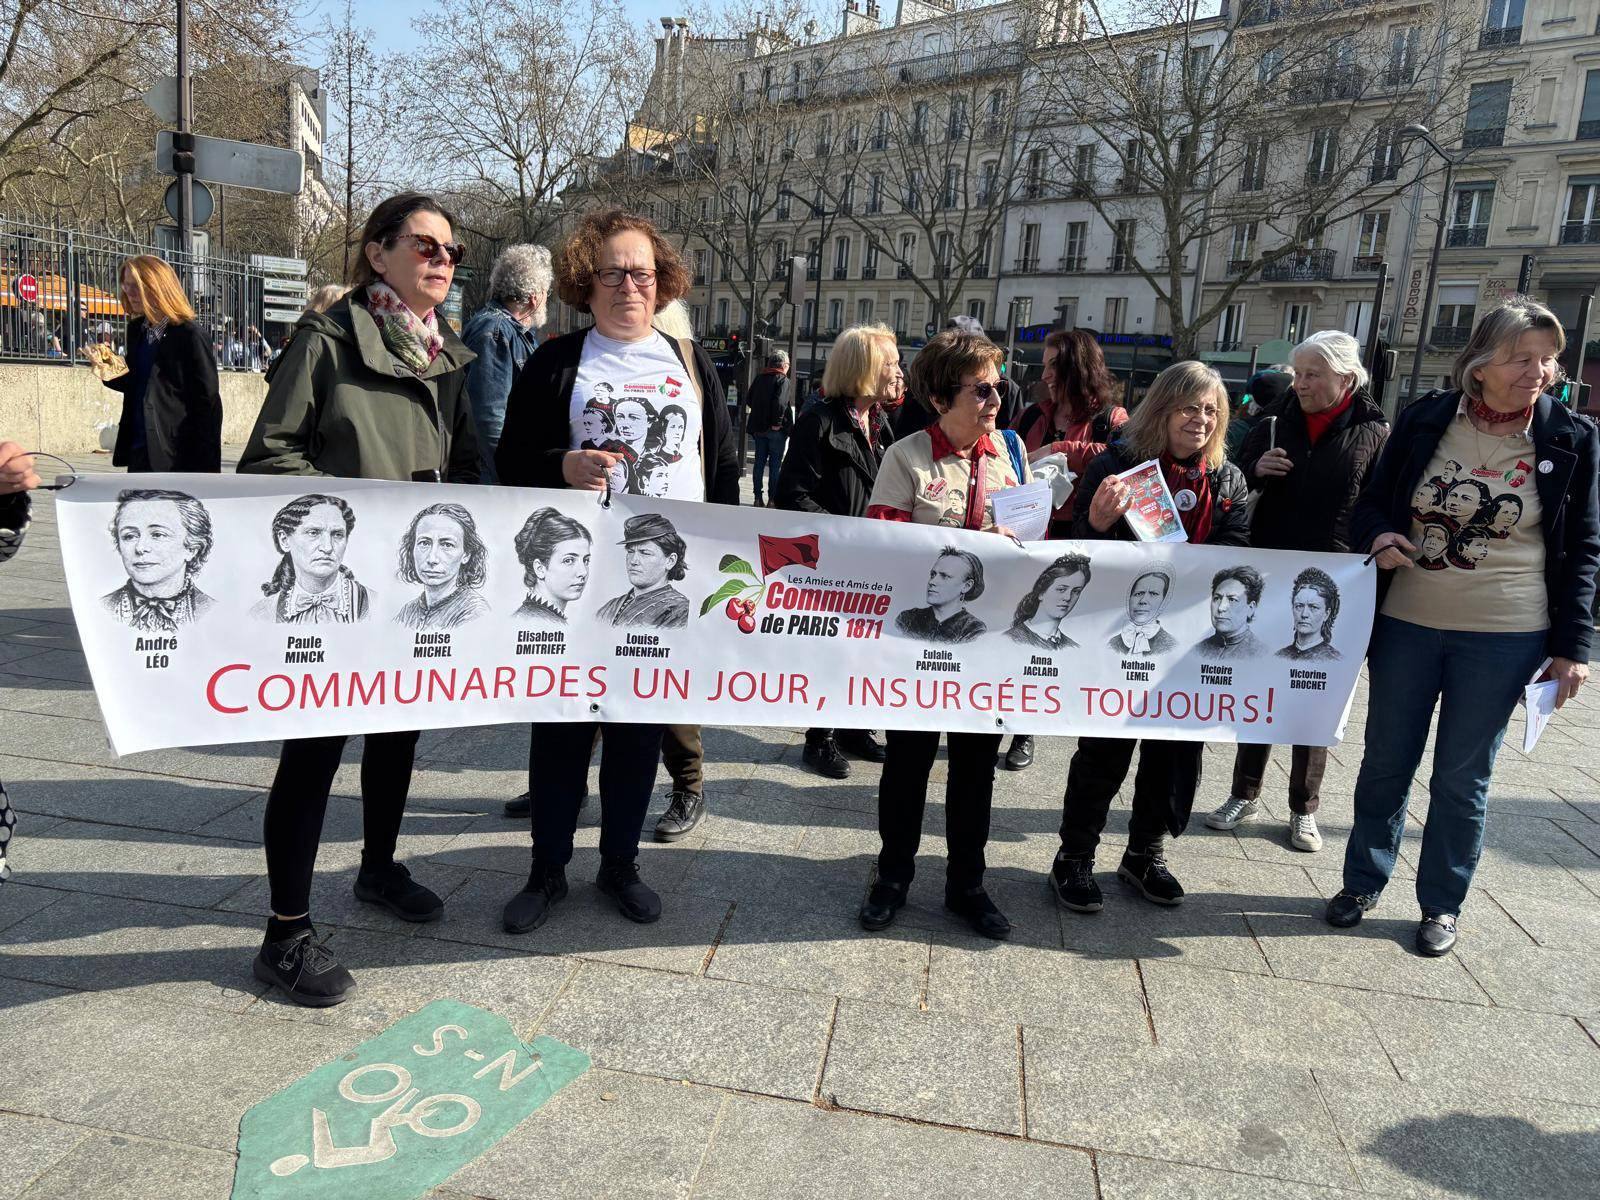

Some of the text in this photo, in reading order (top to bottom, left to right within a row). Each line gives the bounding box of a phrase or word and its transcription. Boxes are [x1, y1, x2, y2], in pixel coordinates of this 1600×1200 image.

[787, 574, 893, 592] Les Amies et Amis de la
[766, 581, 890, 615] Commune
[761, 614, 884, 639] de PARIS 1871
[135, 635, 178, 652] André
[287, 636, 322, 650] Paule
[414, 632, 451, 646] Louise
[517, 631, 565, 644] Elisabeth
[626, 633, 659, 646] Louise
[413, 646, 452, 658] MICHEL
[515, 644, 566, 655] DMITRIEFF
[615, 646, 671, 659] BONENFANT
[922, 649, 953, 661] Eulalie
[146, 654, 169, 669] LÉO
[285, 651, 325, 664] MINCK
[1030, 655, 1053, 667] Anna
[916, 660, 961, 672] PAPAVOINE
[1023, 665, 1060, 678] JACLARD
[1121, 660, 1155, 672] Nathalie
[1201, 664, 1233, 676] Victoire
[1126, 670, 1150, 682] LEMEL
[1201, 675, 1233, 686] TYNAIRE
[1290, 668, 1327, 681] Victorine
[1290, 680, 1327, 691] BROCHET
[632, 668, 691, 701] UN
[707, 670, 826, 711] JOUR,
[848, 676, 1061, 715] INSURGÉES
[1080, 687, 1275, 724] TOUJOURS!
